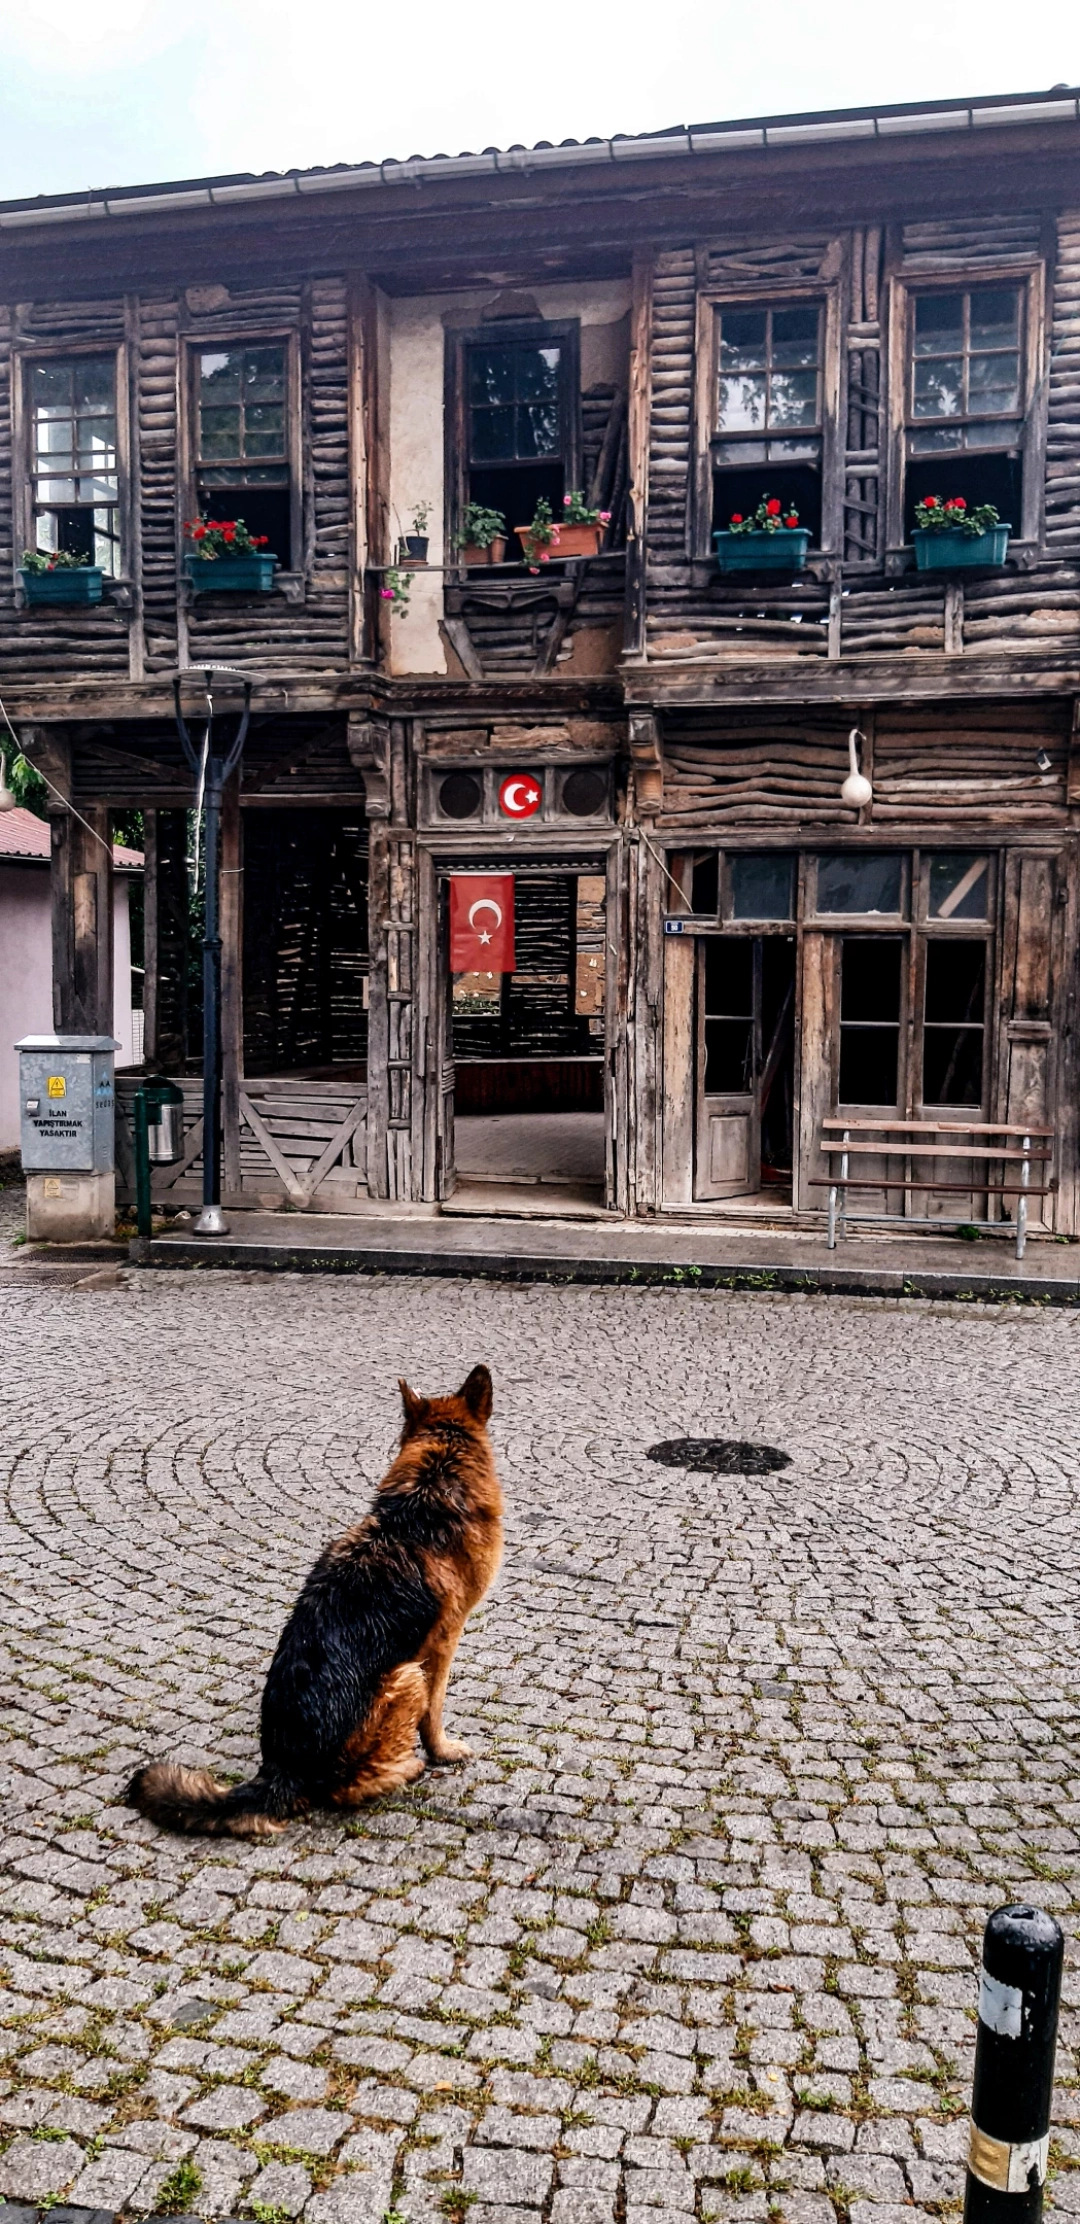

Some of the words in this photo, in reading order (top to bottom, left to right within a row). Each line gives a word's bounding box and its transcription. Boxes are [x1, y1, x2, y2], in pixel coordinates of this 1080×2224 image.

[49, 1109, 67, 1117] İLAN
[33, 1120, 83, 1128] YAPIŞTIRMAK
[39, 1129, 77, 1137] YASAKTIR
